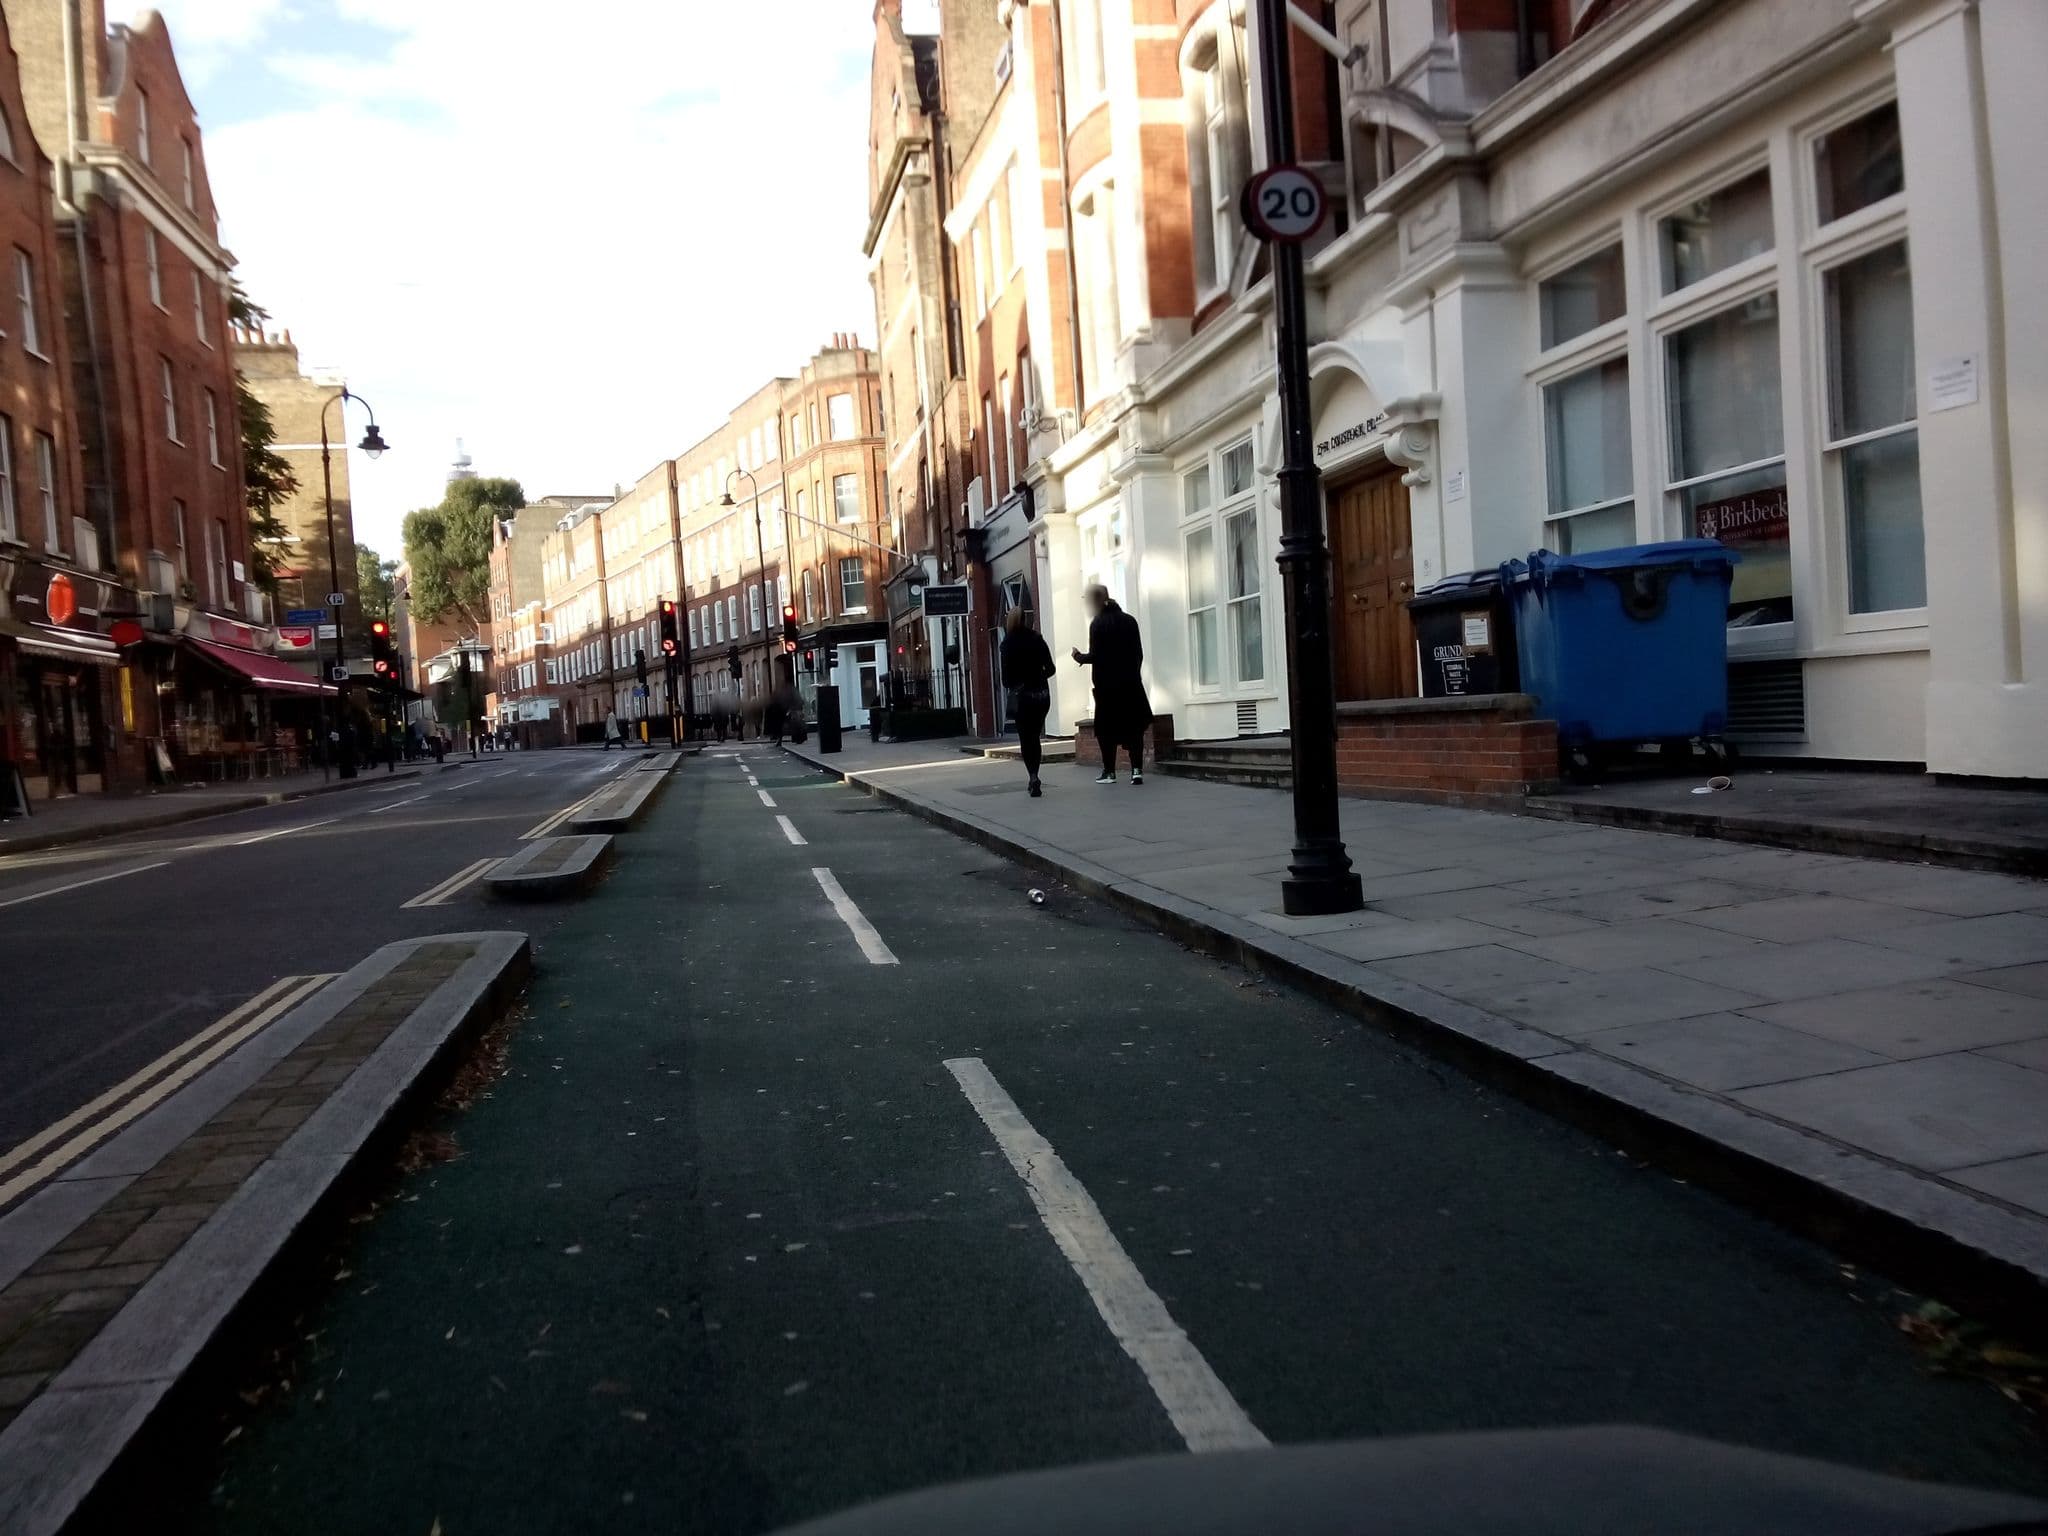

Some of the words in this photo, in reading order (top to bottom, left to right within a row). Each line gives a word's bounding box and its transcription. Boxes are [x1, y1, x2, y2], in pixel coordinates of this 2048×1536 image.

[1263, 187, 1315, 219] 20
[1720, 493, 1788, 529] Birkbeck
[1434, 645, 1473, 657] GRUND
